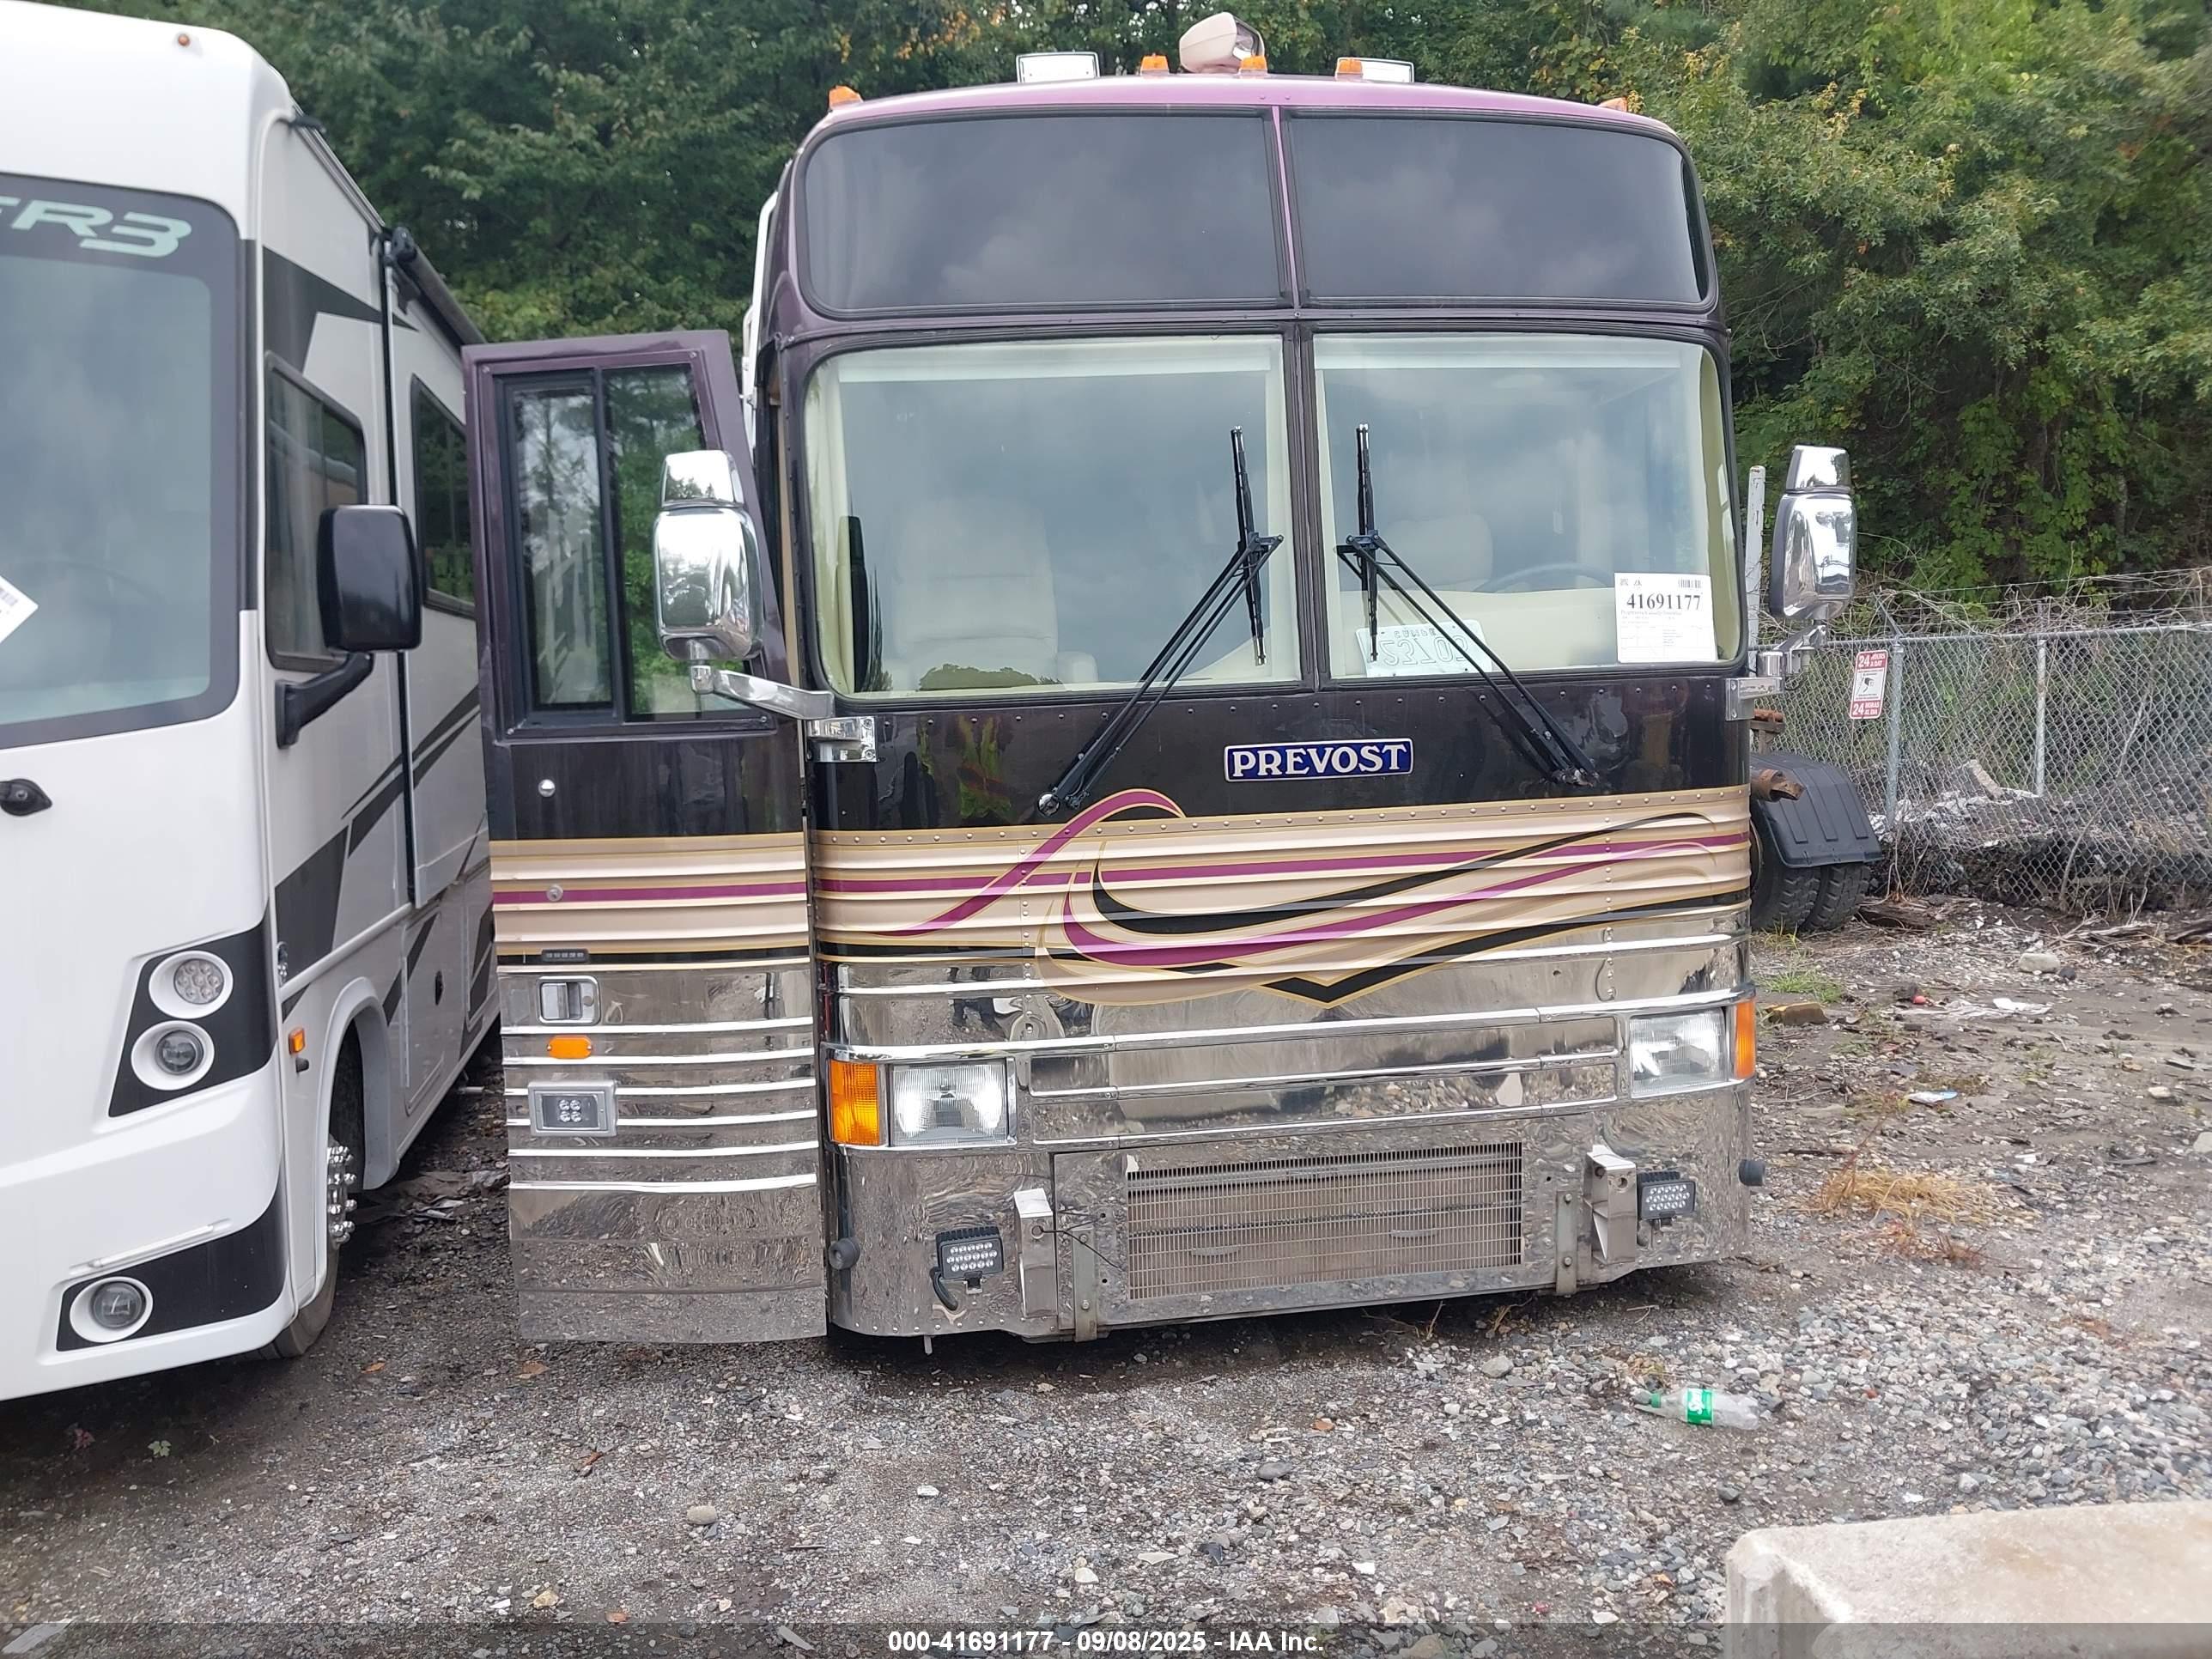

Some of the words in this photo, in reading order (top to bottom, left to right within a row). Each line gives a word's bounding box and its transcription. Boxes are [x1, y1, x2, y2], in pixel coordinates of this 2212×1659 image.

[0, 196, 191, 257] R3
[1626, 592, 1701, 611] 41691177
[1858, 654, 1870, 668] 24
[1853, 703, 1864, 715] 24
[1232, 744, 1407, 777] PREVOST
